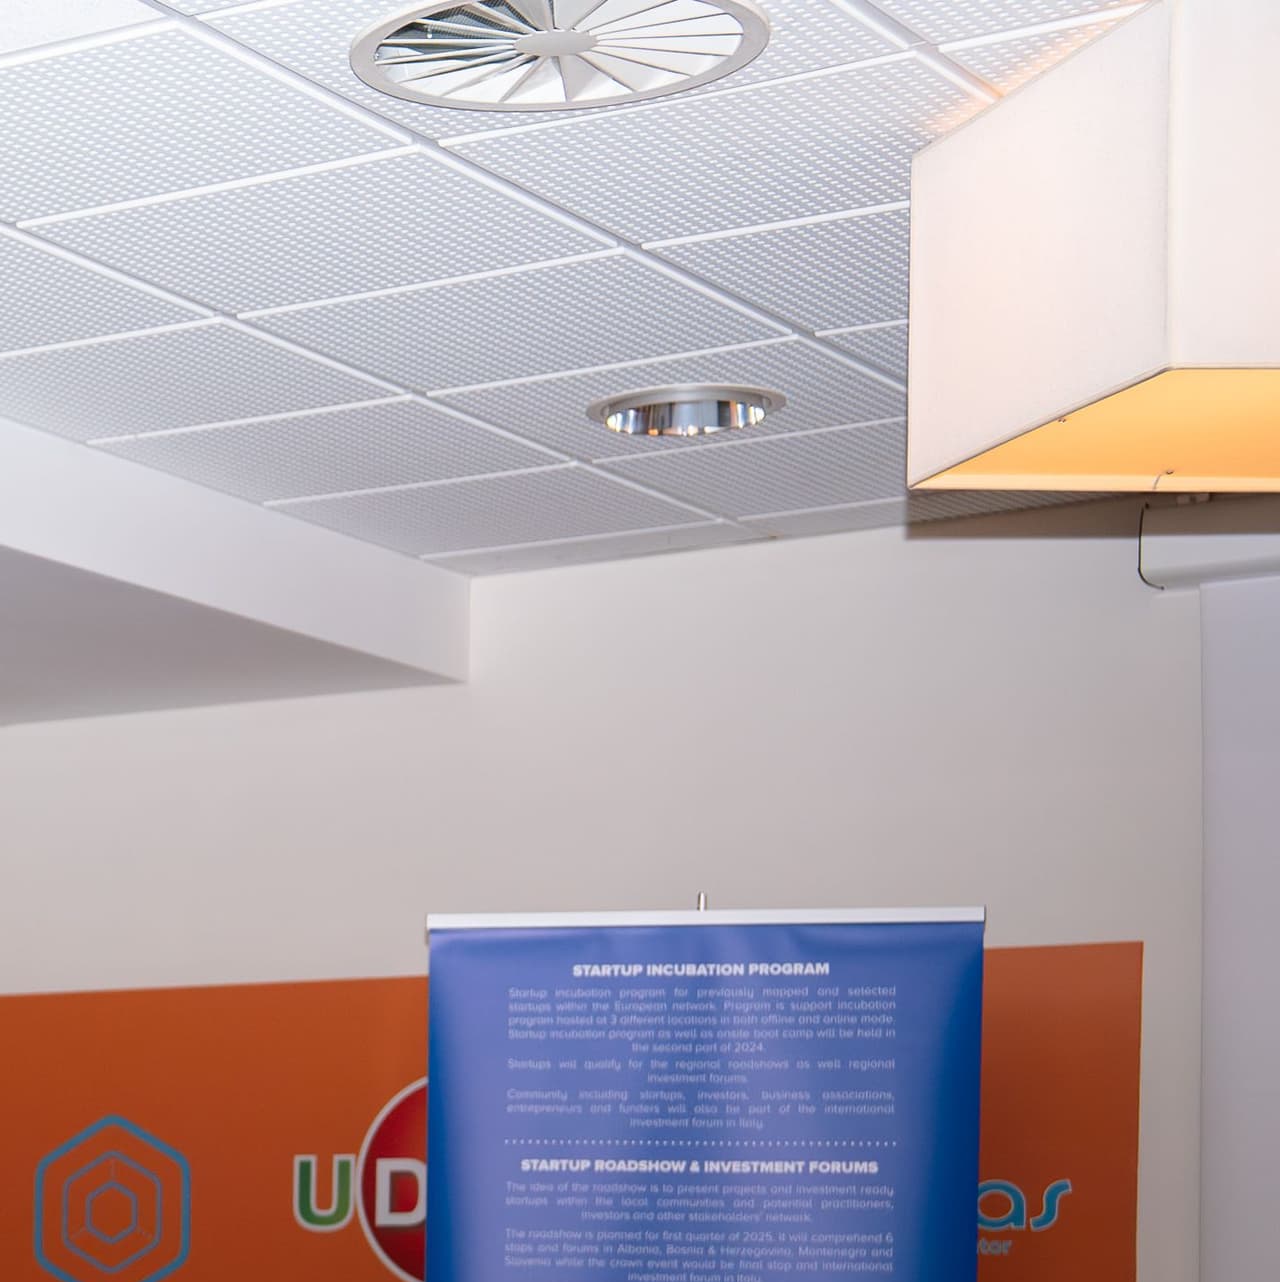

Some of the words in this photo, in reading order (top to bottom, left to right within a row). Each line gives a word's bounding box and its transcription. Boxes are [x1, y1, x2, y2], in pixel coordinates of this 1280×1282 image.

[573, 964, 643, 976] STARTUP
[647, 963, 745, 976] INCUBATION
[749, 963, 830, 975] PROGRAM
[521, 1160, 591, 1172] STARTUP
[595, 1160, 686, 1172] ROADSHOW
[690, 1161, 700, 1172] &
[704, 1161, 805, 1173] INVESTMENT
[809, 1161, 879, 1173] FORUMS
